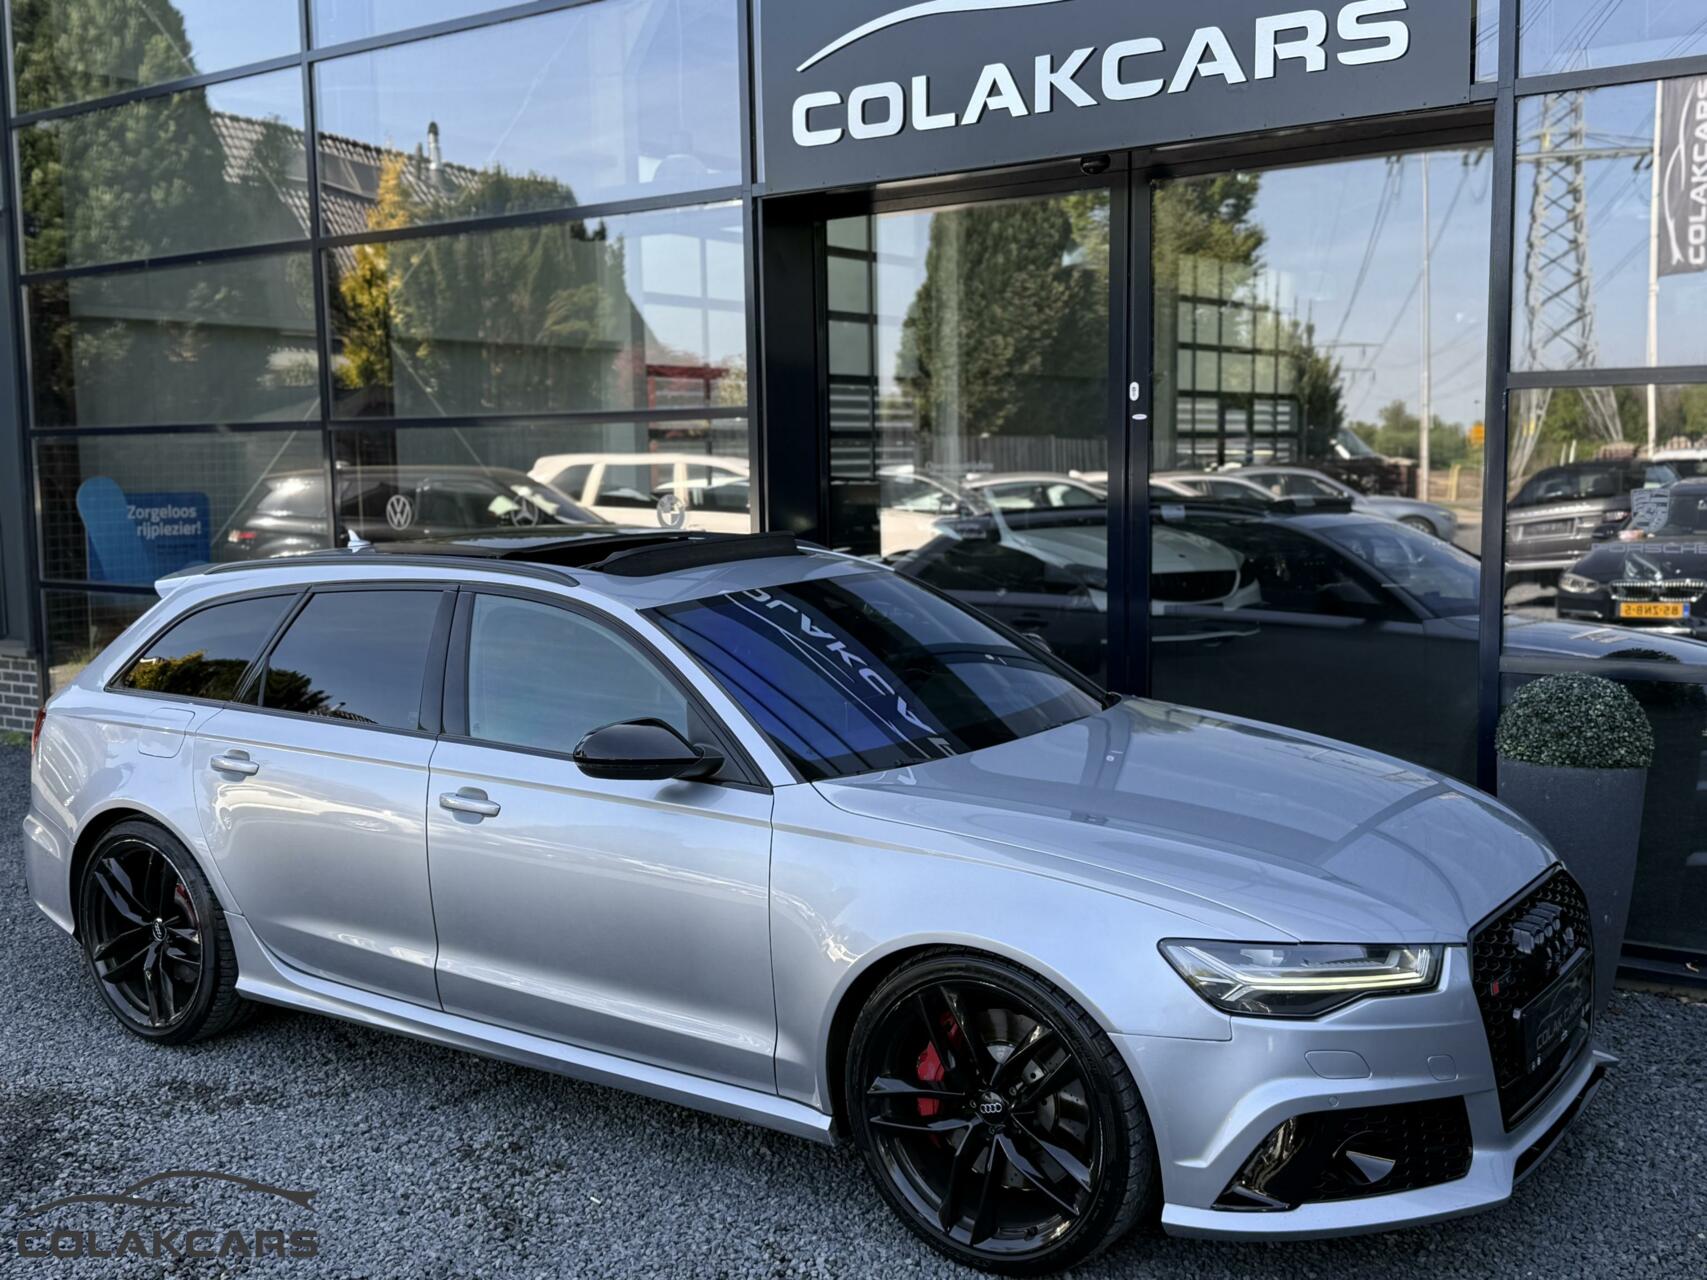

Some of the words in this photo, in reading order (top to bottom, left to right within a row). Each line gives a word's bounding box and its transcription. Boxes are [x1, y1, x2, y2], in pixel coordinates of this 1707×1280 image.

[792, 0, 1410, 147] COLAKCARS
[127, 505, 197, 523] Zorgeloos
[136, 521, 202, 540] rijplezier!
